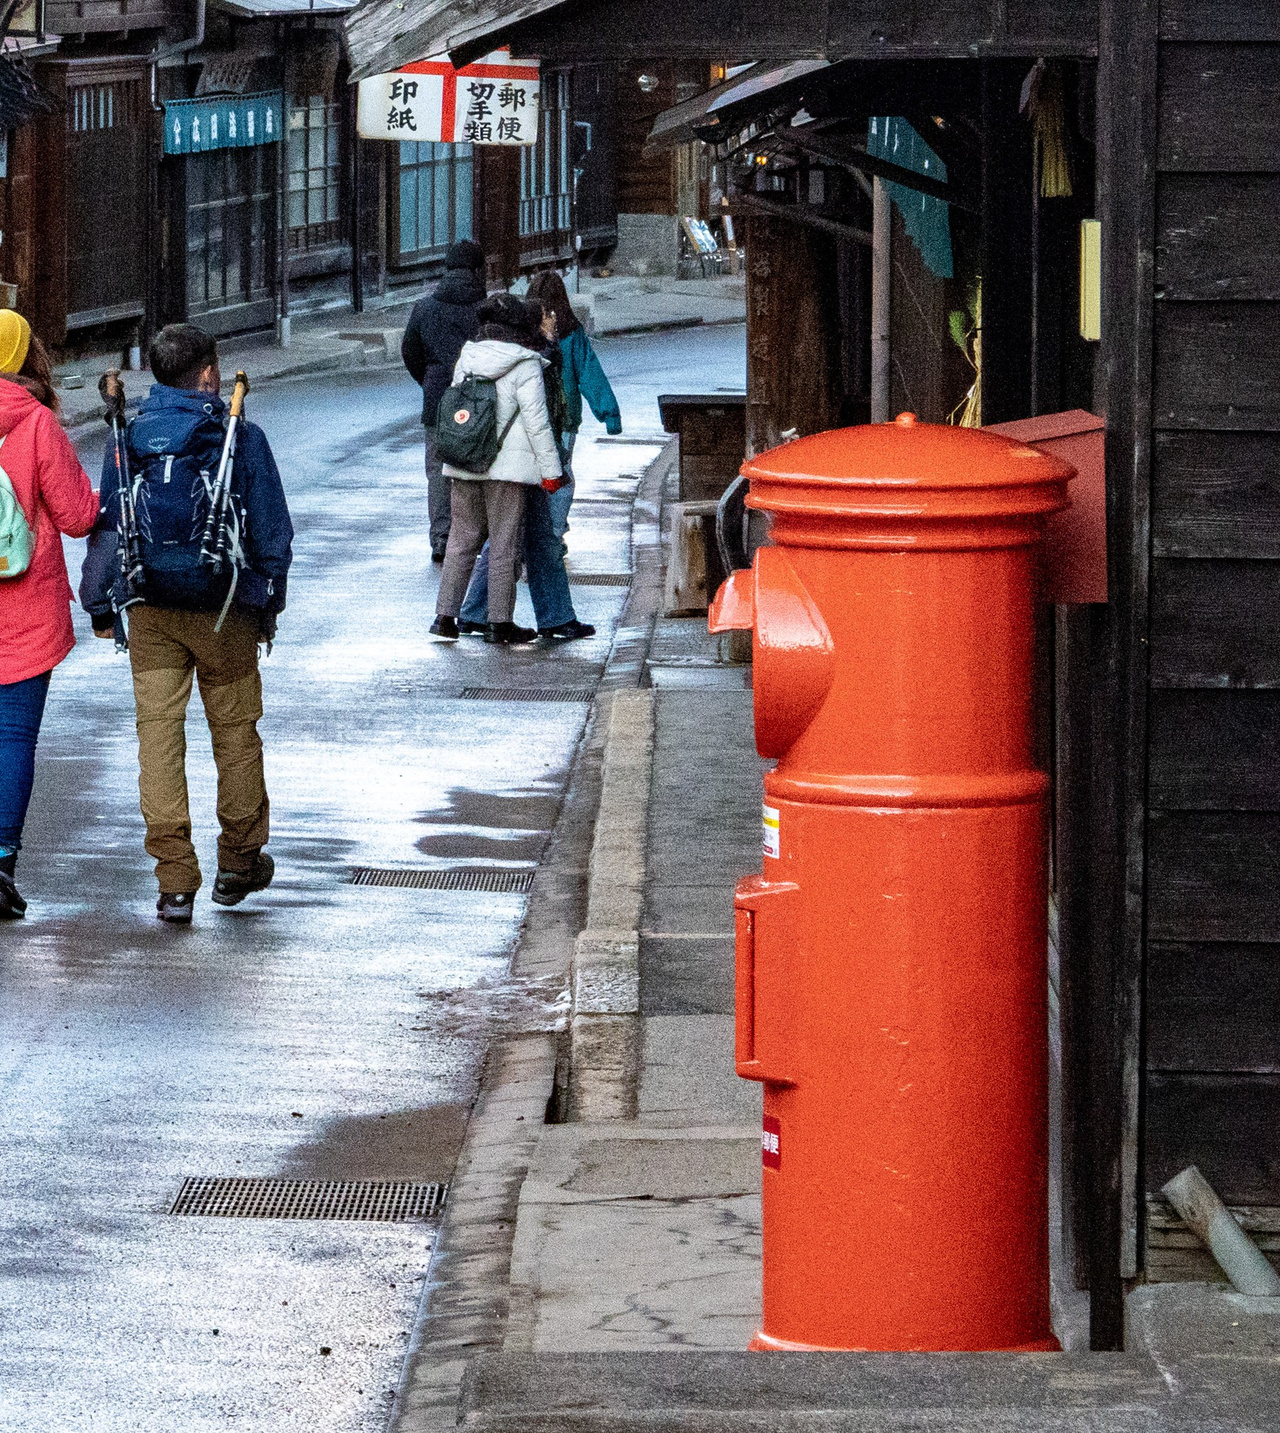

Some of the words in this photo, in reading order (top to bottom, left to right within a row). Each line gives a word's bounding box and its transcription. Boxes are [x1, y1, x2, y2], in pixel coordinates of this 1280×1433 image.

[386, 77, 419, 132] 印紙
[464, 81, 496, 142] 切手類
[497, 82, 526, 142] 郵便
